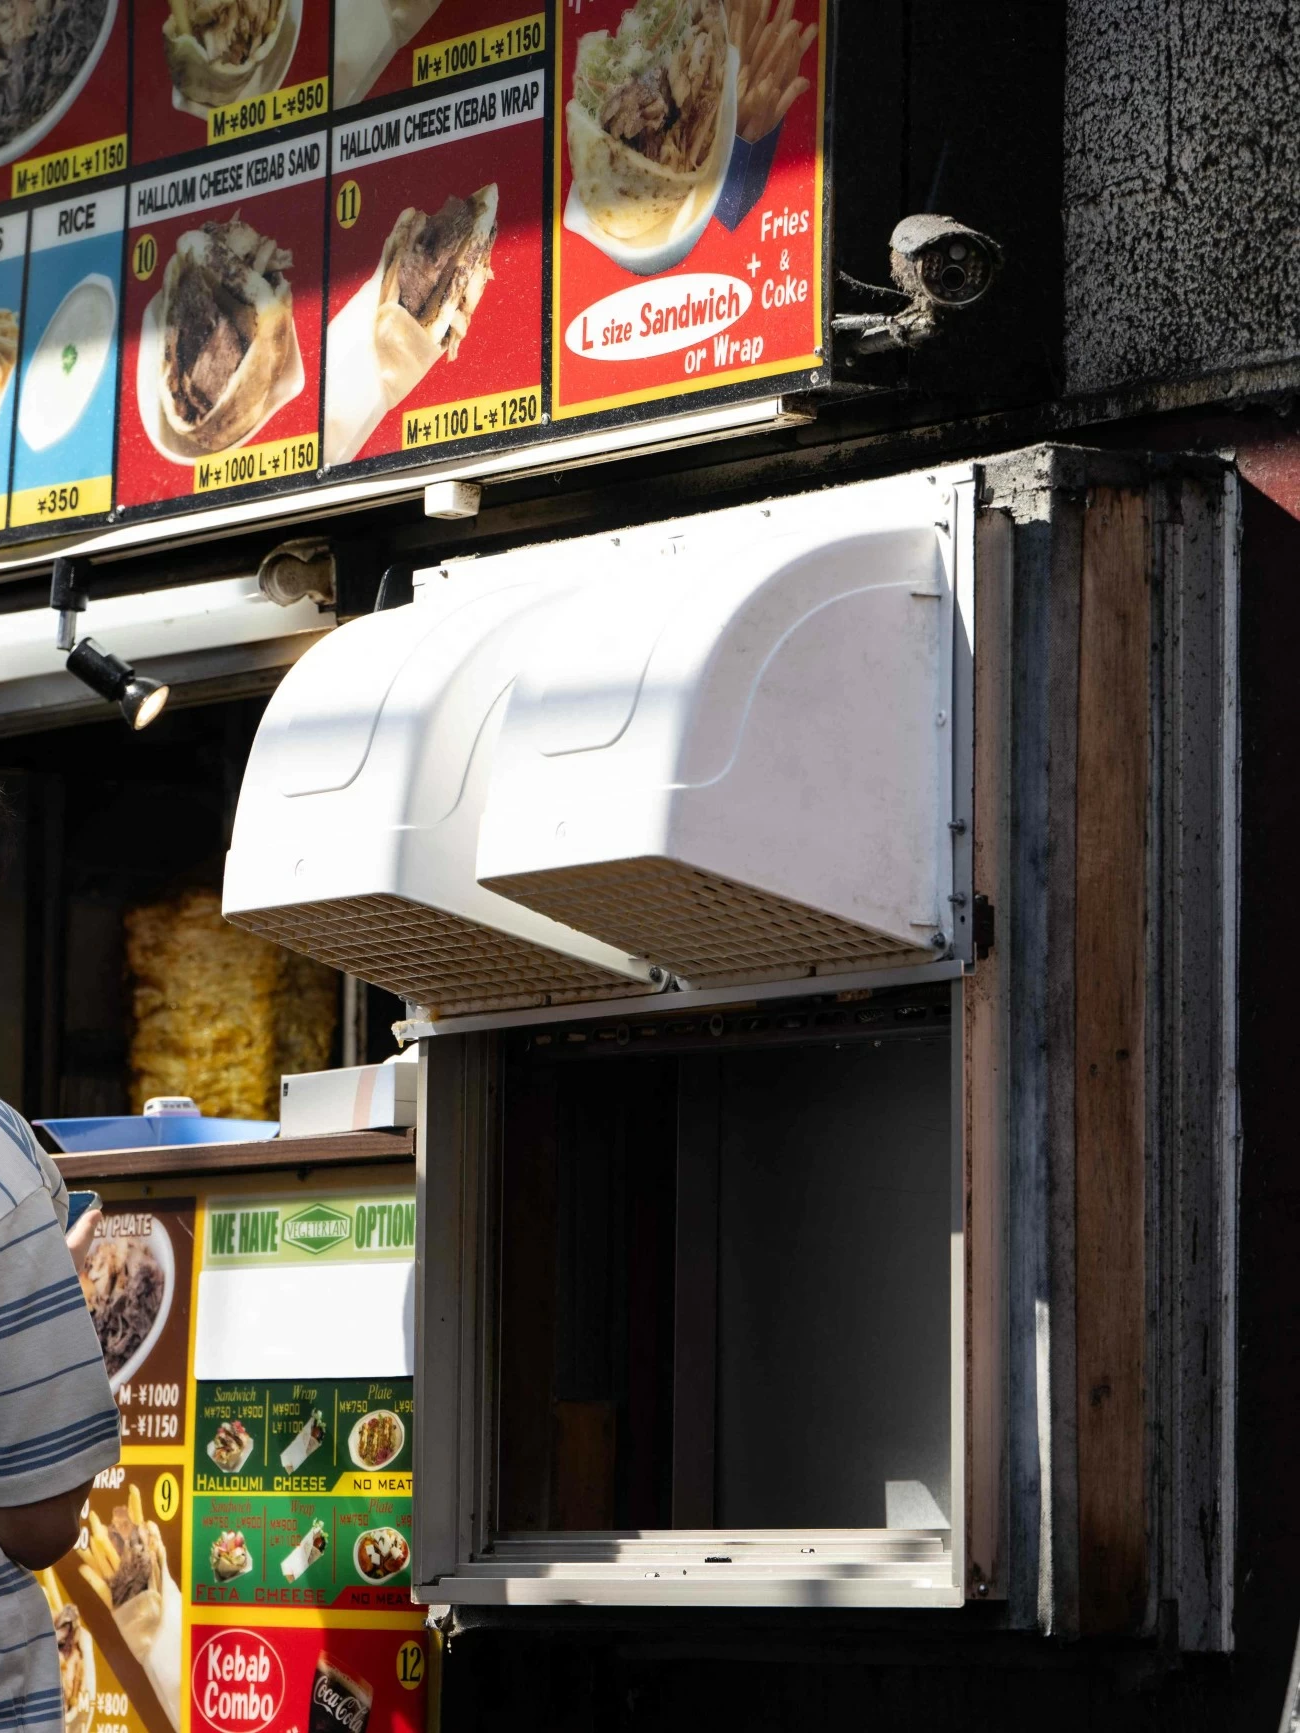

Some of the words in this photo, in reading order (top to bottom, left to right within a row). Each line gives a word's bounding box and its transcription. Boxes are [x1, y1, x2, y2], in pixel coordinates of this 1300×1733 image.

[417, 41, 476, 81] M-¥1000
[481, 22, 541, 63] L-¥1150
[213, 100, 266, 137] M-¥800
[273, 83, 324, 120] L-¥950
[339, 119, 400, 162] HALLOUMI
[404, 105, 451, 144] CHEESE
[454, 92, 497, 130] KEBAB
[501, 81, 540, 117] WRAP
[16, 158, 70, 193] M-¥1000
[72, 143, 125, 179] L-¥1150
[137, 176, 196, 216] HALLOUMI
[200, 163, 244, 200] CHEESE
[246, 153, 285, 188] KEBAB
[288, 143, 320, 176] SAND
[58, 202, 97, 237] RICE
[339, 185, 357, 223] 11
[760, 207, 809, 242] Fries
[136, 238, 156, 275] 10
[760, 274, 808, 310] Coke
[581, 316, 594, 351] L
[602, 319, 632, 343] size
[639, 283, 741, 338] Sandwich
[684, 349, 707, 374] or
[713, 333, 764, 366] Wrap
[406, 405, 469, 445] M-¥1100
[473, 396, 537, 431] L-¥1250
[199, 453, 255, 488] M-¥1000
[259, 441, 315, 476] L-¥1150
[38, 486, 80, 514] ¥350
[111, 1212, 153, 1238] PLATE
[211, 1213, 236, 1255] WE
[238, 1211, 280, 1254] HAVE
[286, 1219, 349, 1239] VEGETERIAN
[354, 1203, 416, 1249] OPTION
[118, 1383, 180, 1407] M-¥1000
[214, 1385, 257, 1402] Sandwich
[272, 1403, 300, 1416] M¥900
[292, 1385, 318, 1402] Wrap
[339, 1401, 368, 1413] M¥750
[394, 1400, 414, 1413] L¥90
[367, 1384, 393, 1400] Plate
[120, 1413, 179, 1438] L-¥1150
[204, 1405, 231, 1419] M¥750
[237, 1405, 264, 1418] L¥900
[160, 1479, 172, 1513] 9
[196, 1474, 263, 1491] HALLOUMI
[273, 1476, 327, 1491] CHEESE
[353, 1479, 372, 1490] NO
[378, 1479, 413, 1490] MEAT
[195, 1583, 240, 1602] FETA
[255, 1588, 326, 1604] CHEESE
[351, 1593, 371, 1605] NO
[376, 1593, 411, 1606] MEAT
[207, 1644, 271, 1682] Kebab
[399, 1646, 422, 1682] 12
[203, 1682, 274, 1721] Combo
